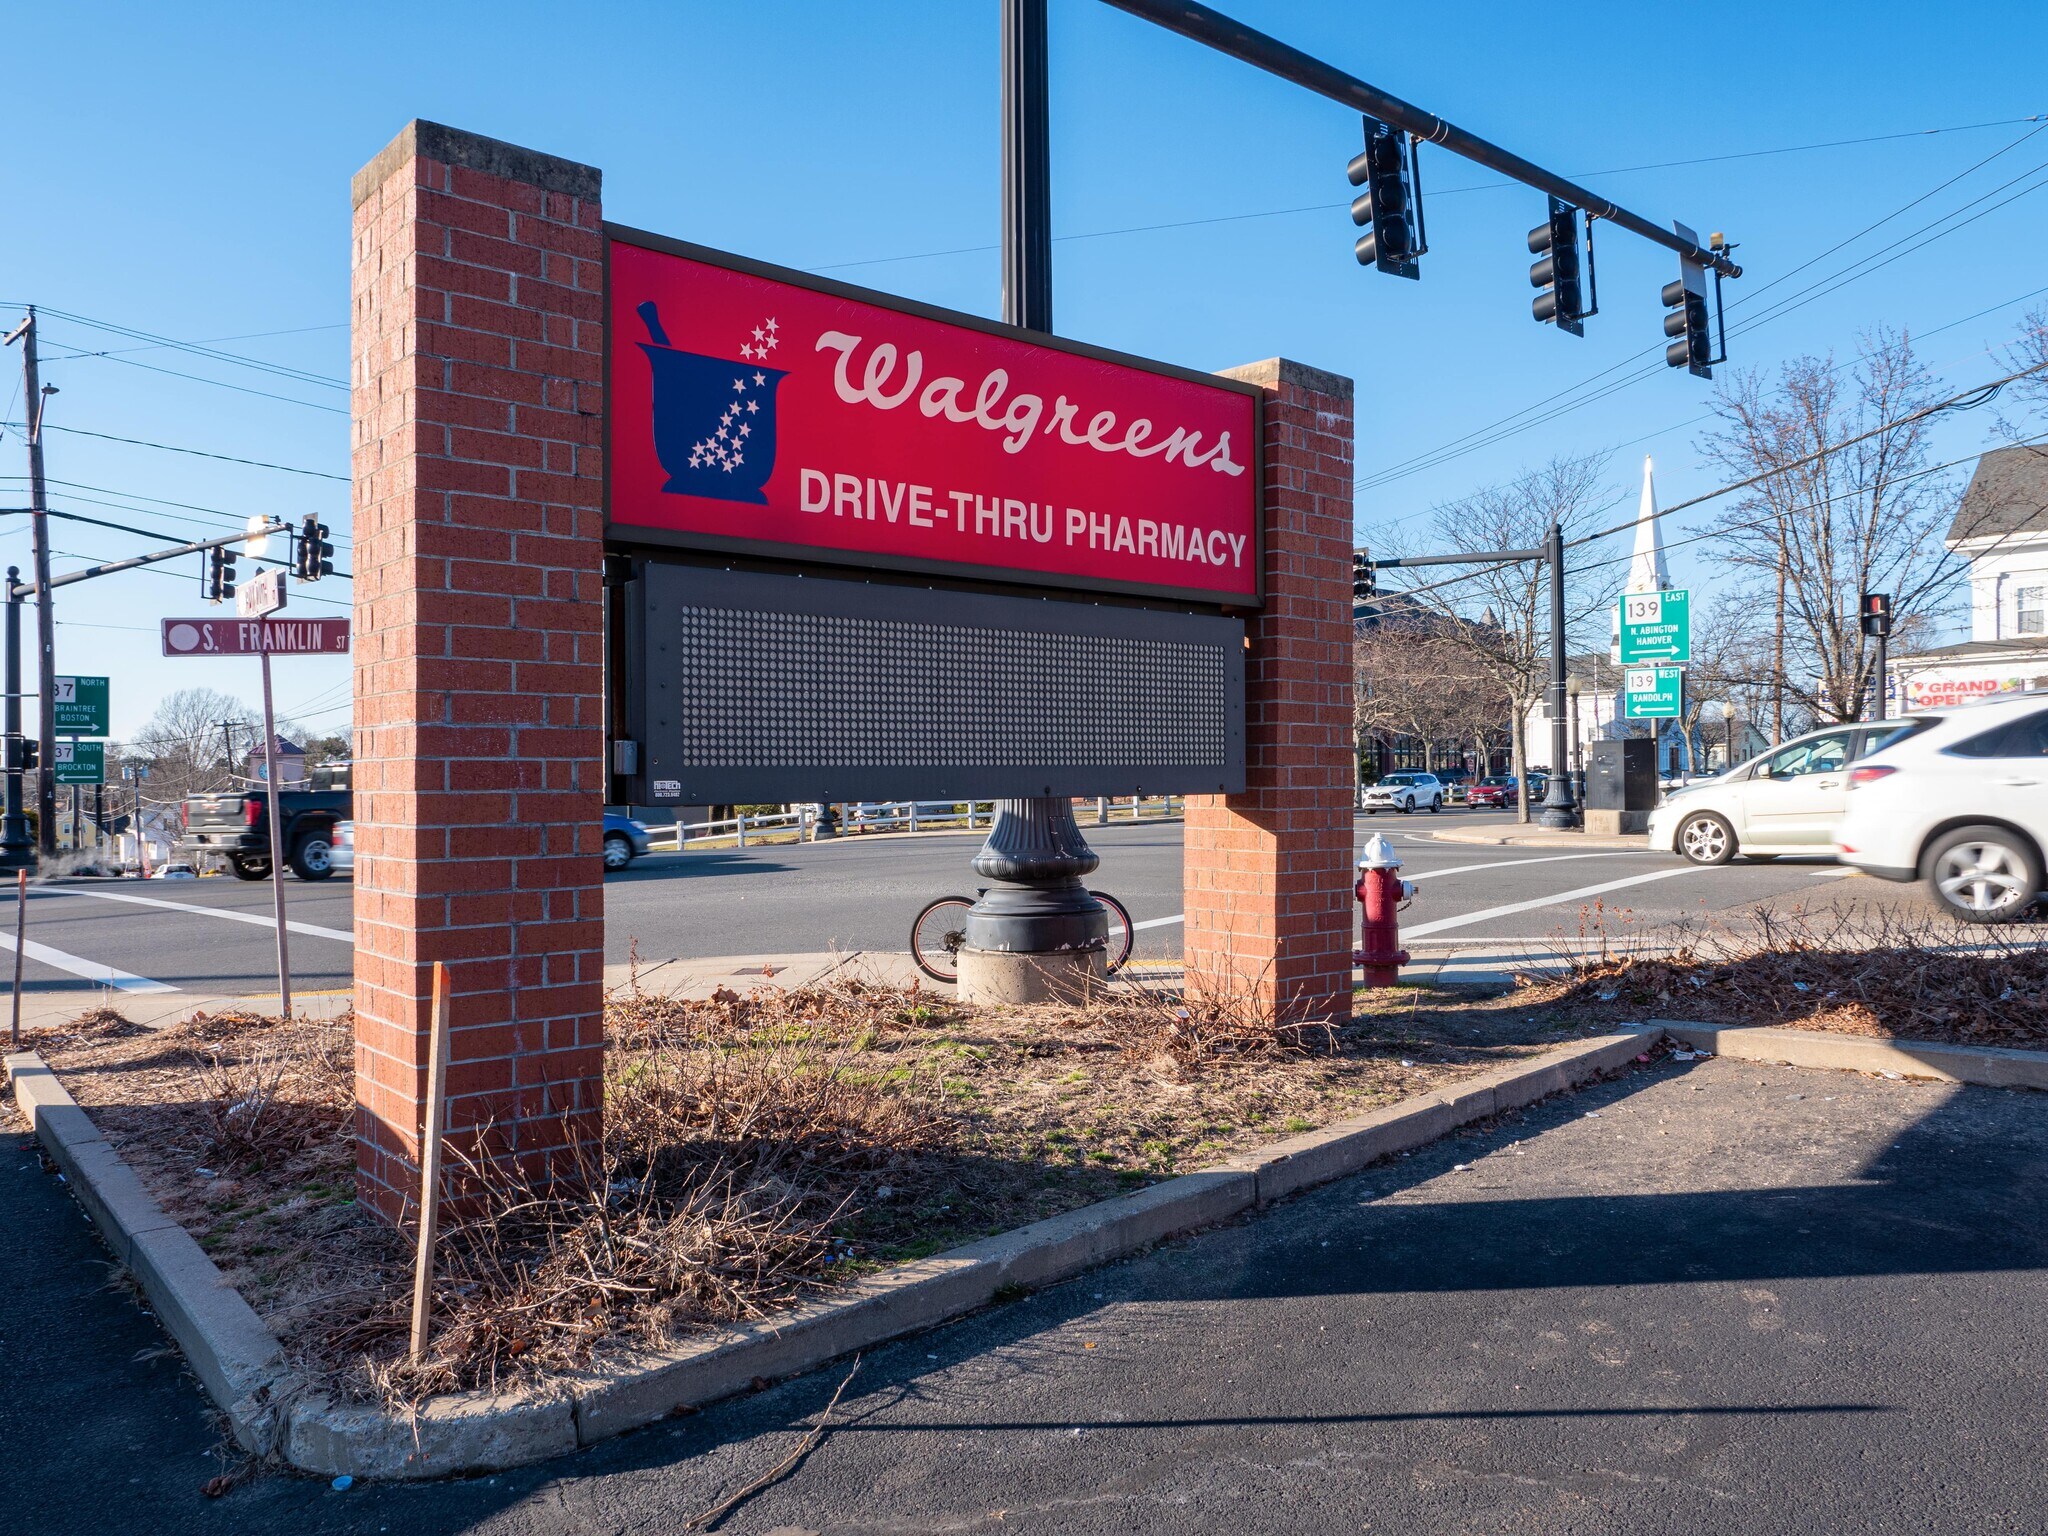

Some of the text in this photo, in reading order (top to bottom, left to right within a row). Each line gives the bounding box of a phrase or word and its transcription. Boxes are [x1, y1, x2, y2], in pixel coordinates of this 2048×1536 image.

[815, 331, 1245, 476] Walgreens
[800, 468, 1246, 567] DRIVE-THRU PHARMACY
[1665, 592, 1686, 602] EAST
[1628, 601, 1659, 618] 139
[1640, 624, 1679, 635] ABINGTON
[202, 623, 346, 651] S. FRANKLIN ST
[1636, 635, 1673, 646] HANOVER
[1658, 669, 1679, 679] WEST
[80, 678, 105, 687] NORTH
[1630, 675, 1654, 688] 139
[1928, 680, 1997, 693] GRAND
[1632, 692, 1673, 702] RANDOLPH
[55, 704, 97, 713] BRAINTREE
[60, 714, 90, 722] BOSTON
[77, 743, 102, 752] SOUTH
[57, 763, 96, 771] BROCKTON
